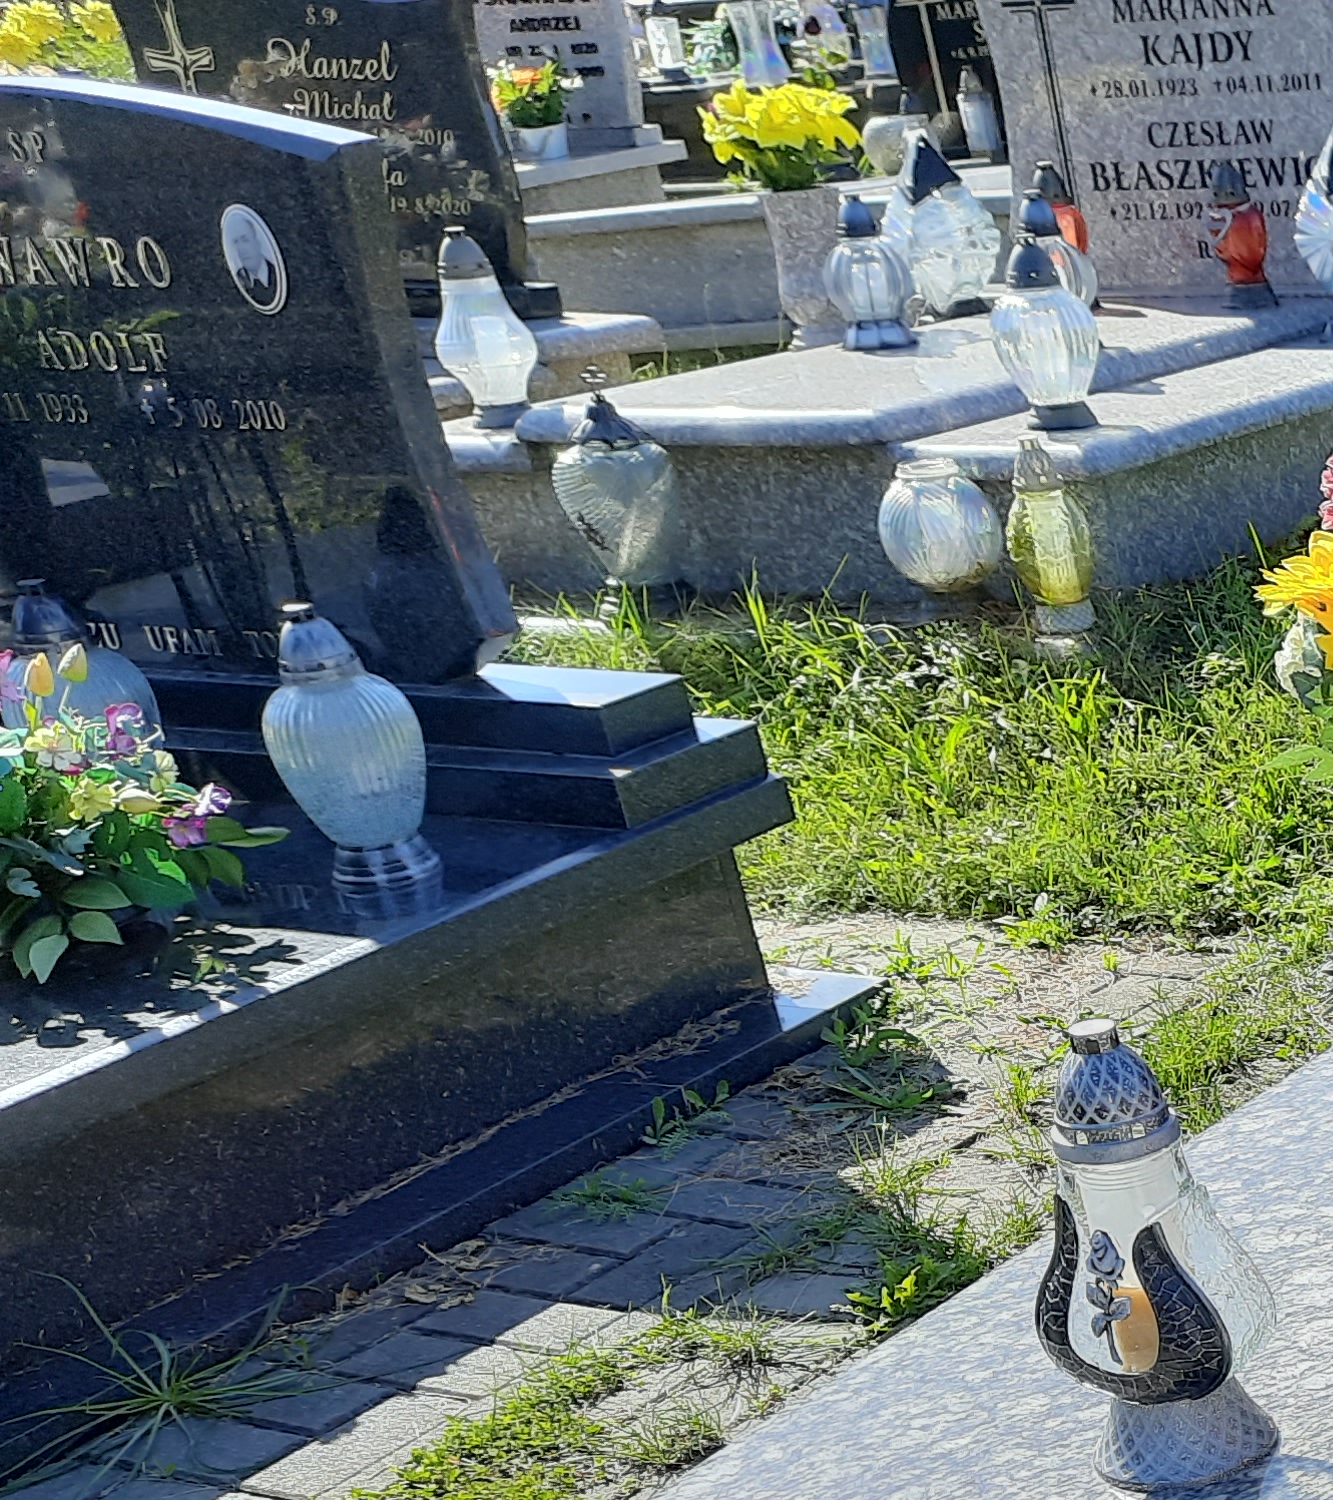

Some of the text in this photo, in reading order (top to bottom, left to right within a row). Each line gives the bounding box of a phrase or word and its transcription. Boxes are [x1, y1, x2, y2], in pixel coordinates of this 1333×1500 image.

[1112, 0, 1276, 25] MARIANNA
[262, 38, 398, 82] Hanzel
[1138, 30, 1254, 72] KAJDY
[1146, 119, 1274, 149] CZESŁAW
[1089, 154, 1319, 192] BŁASZKEWIC
[1123, 202, 1212, 221] 21.12.192
[36, 329, 169, 373] ADOLF
[231, 398, 288, 431] 2010
[141, 623, 224, 657] UFAM
